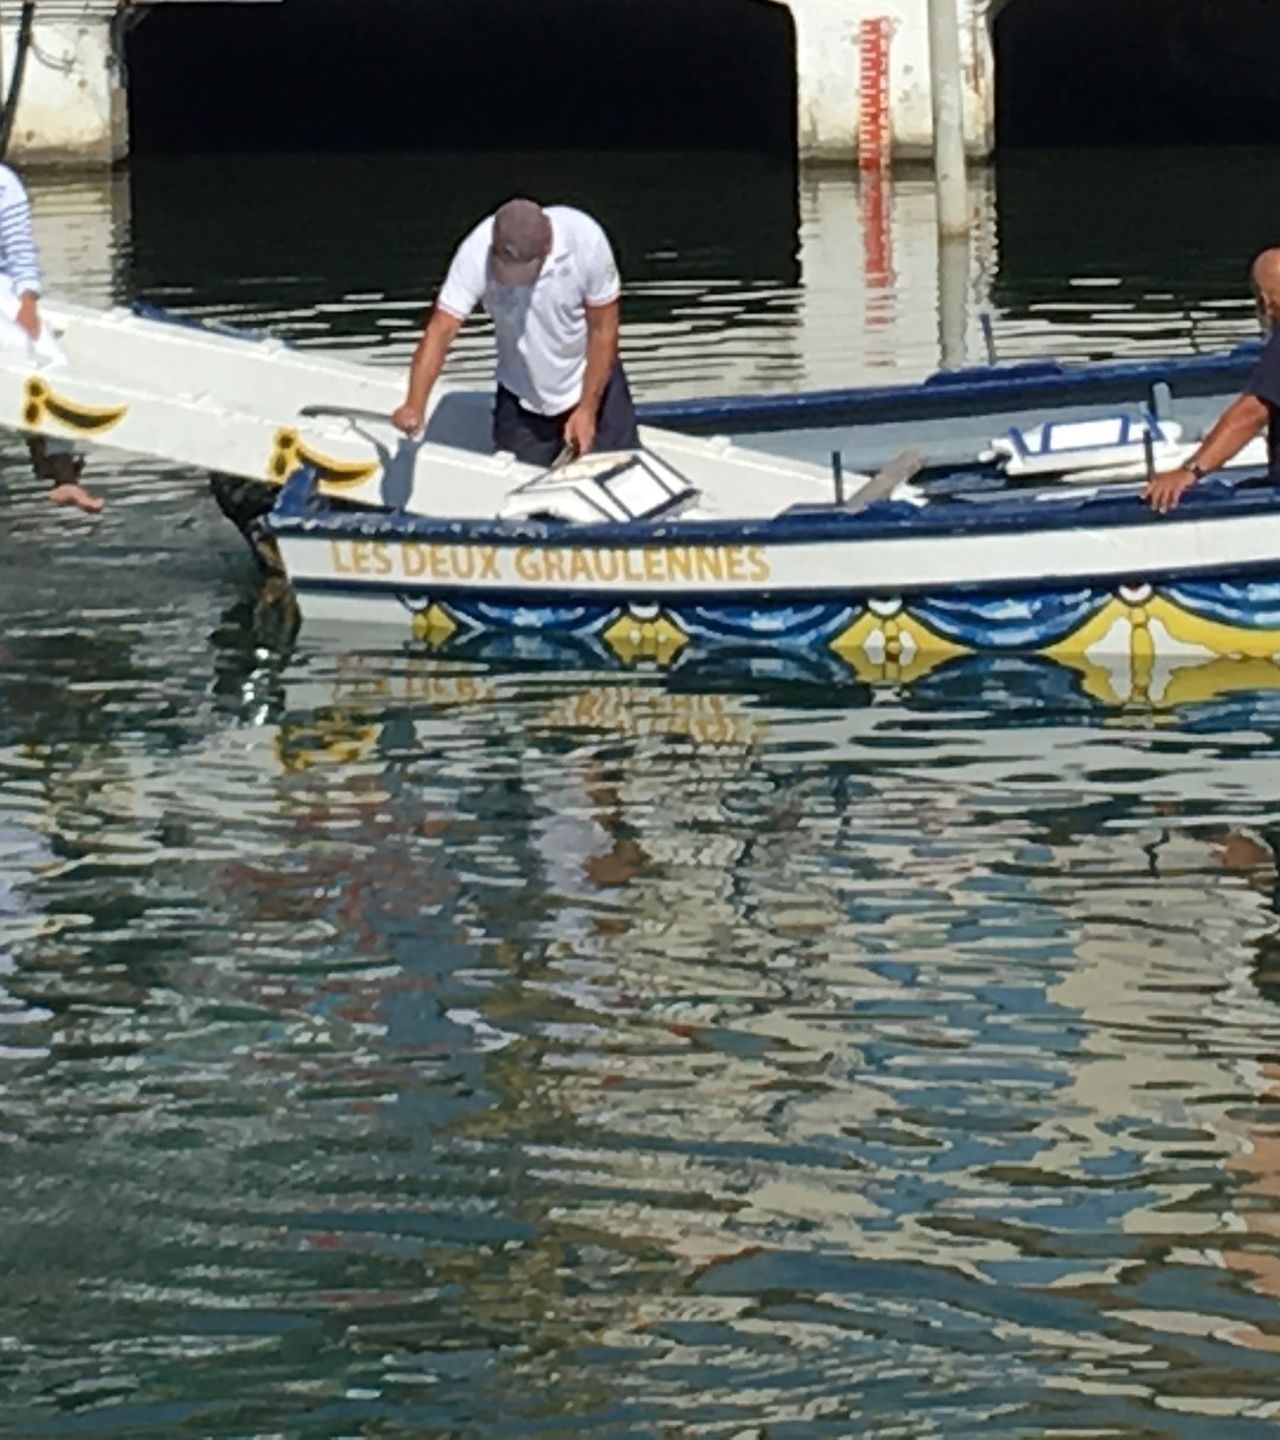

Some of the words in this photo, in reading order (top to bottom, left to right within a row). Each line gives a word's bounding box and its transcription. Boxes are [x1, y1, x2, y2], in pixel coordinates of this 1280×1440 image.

[329, 539, 395, 575] LES
[401, 541, 503, 580] DEUX
[514, 543, 772, 583] GRAULENNES
